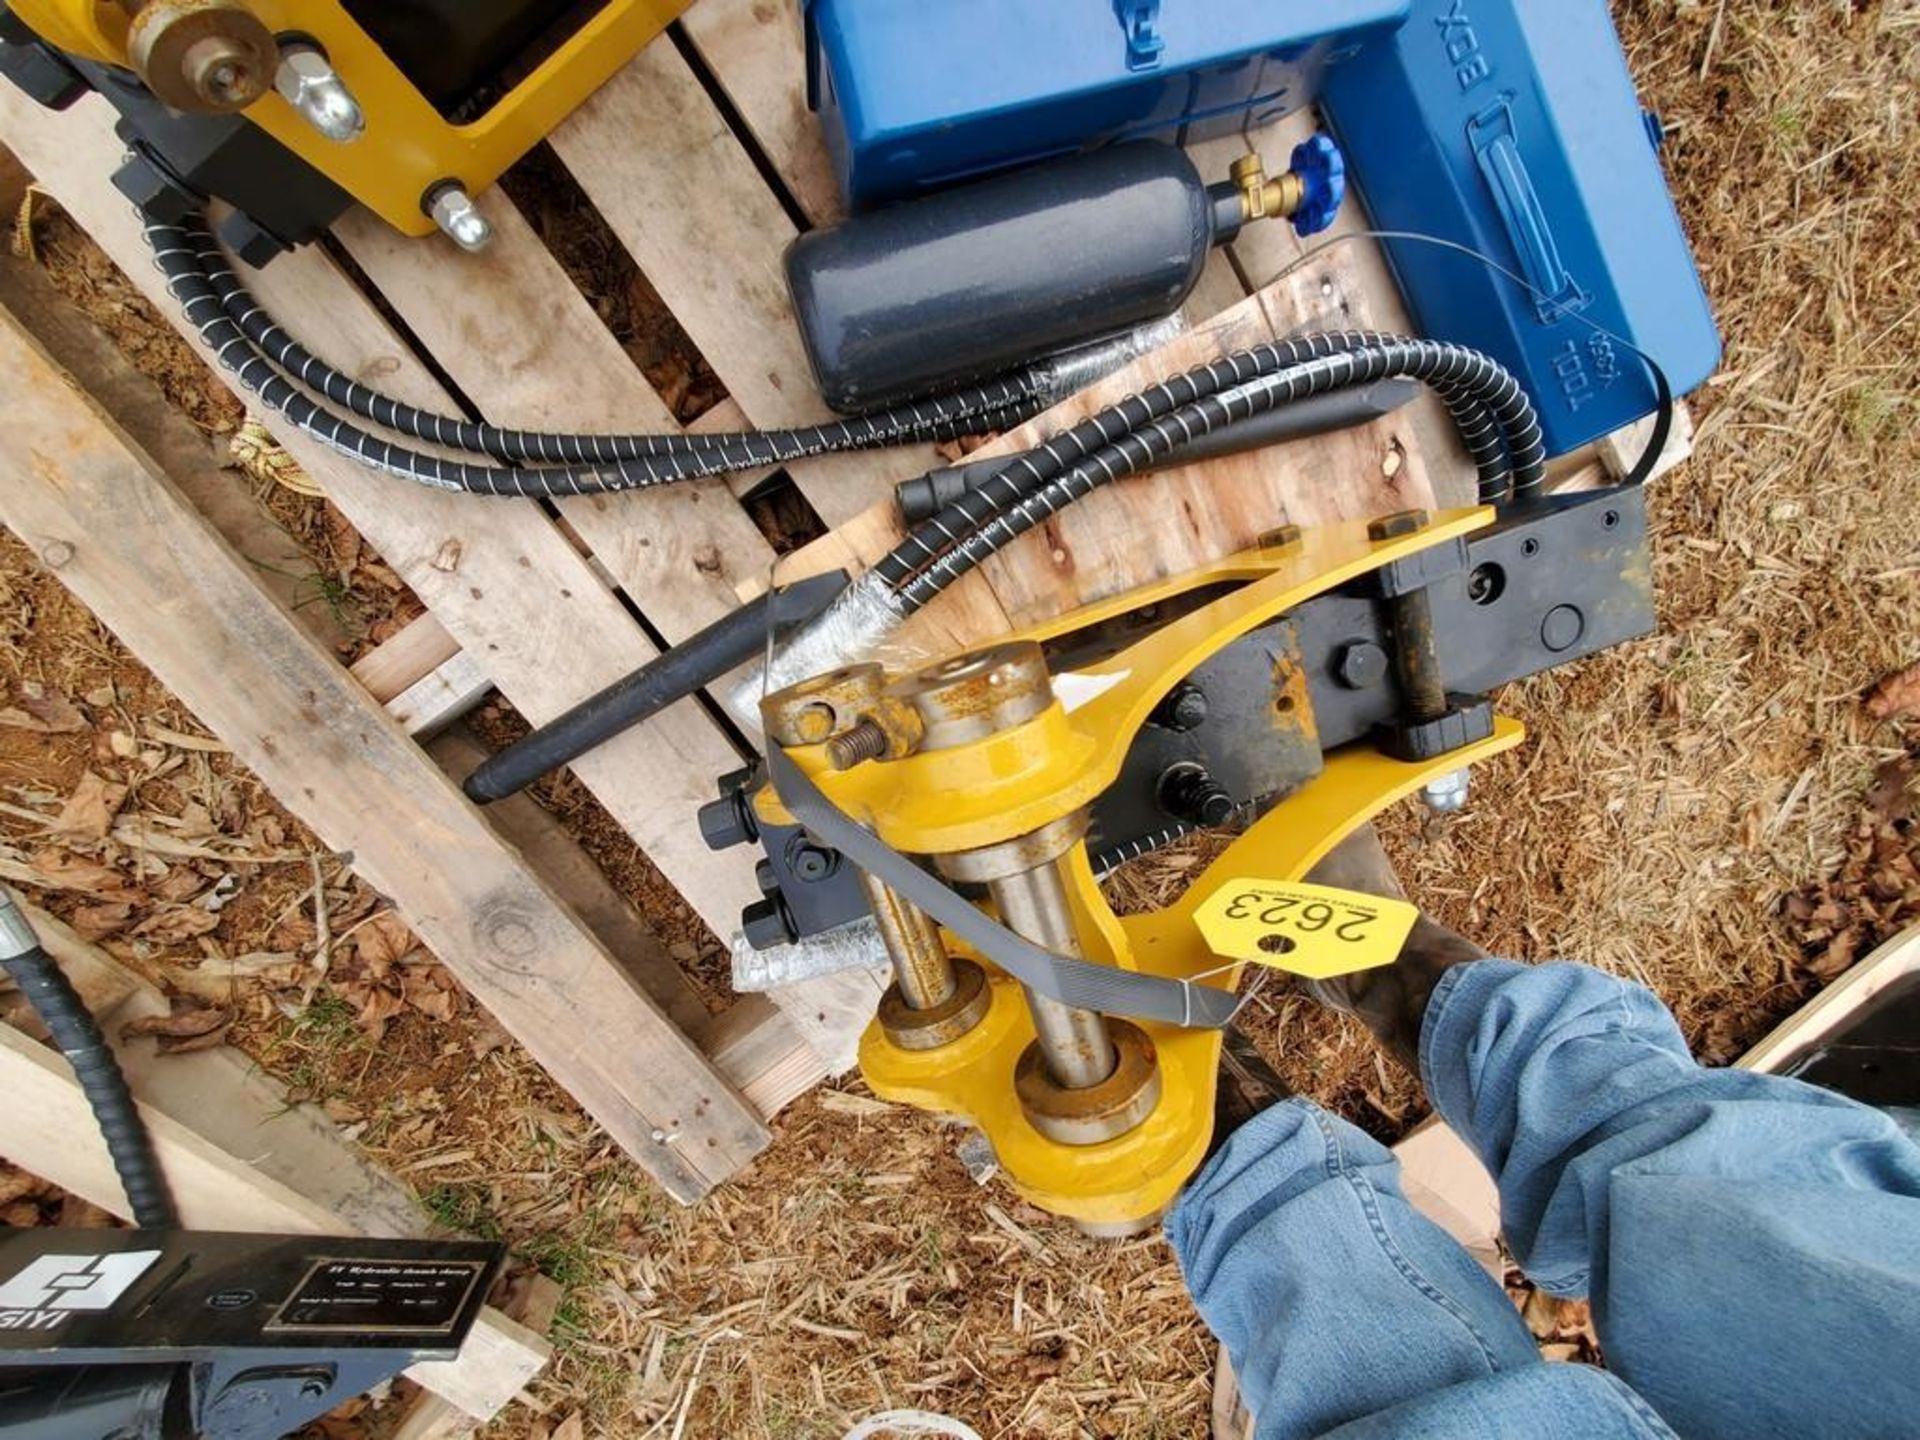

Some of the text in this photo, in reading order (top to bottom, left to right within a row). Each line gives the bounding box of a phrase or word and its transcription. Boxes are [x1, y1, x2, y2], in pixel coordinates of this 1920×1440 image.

[1433, 0, 1595, 412] TOOL BOX
[1225, 893, 1379, 942] 2623
